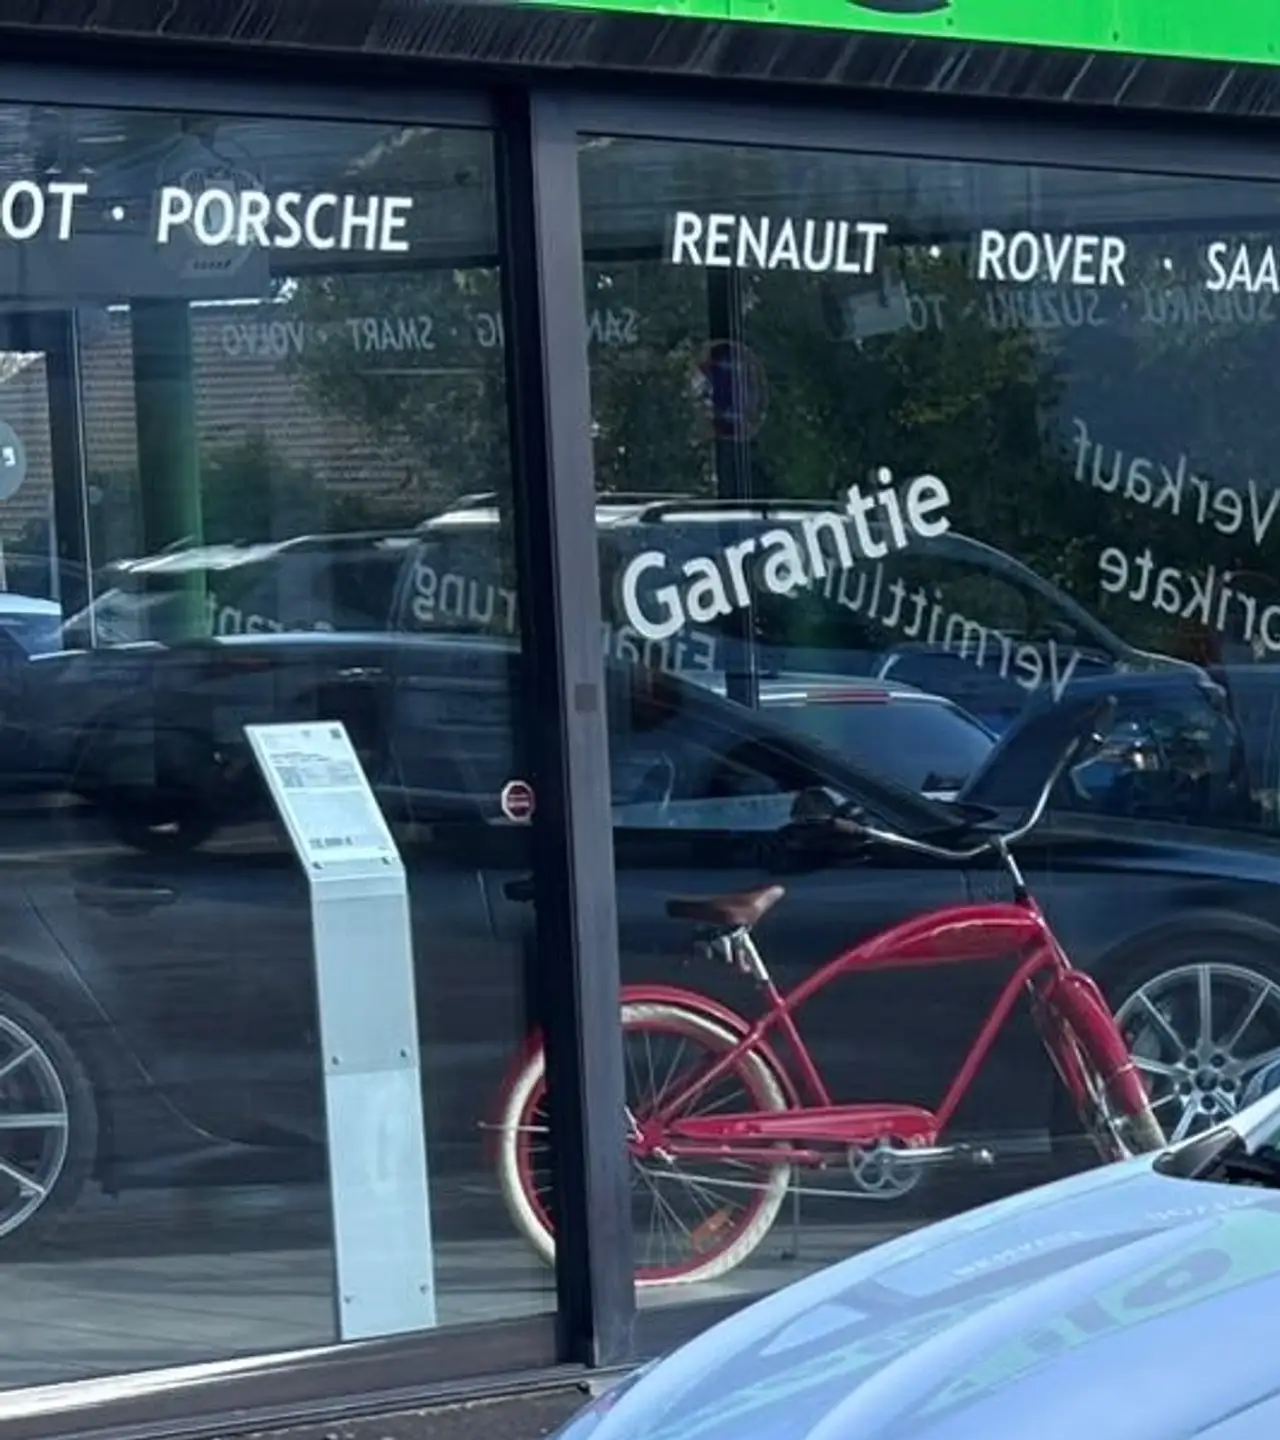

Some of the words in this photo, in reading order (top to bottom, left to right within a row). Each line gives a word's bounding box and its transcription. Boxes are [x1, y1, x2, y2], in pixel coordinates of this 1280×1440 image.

[157, 186, 413, 252] PORSCHE
[671, 210, 889, 274] RENAULT
[976, 229, 1127, 287] ROVER
[622, 466, 952, 641] Garantie
